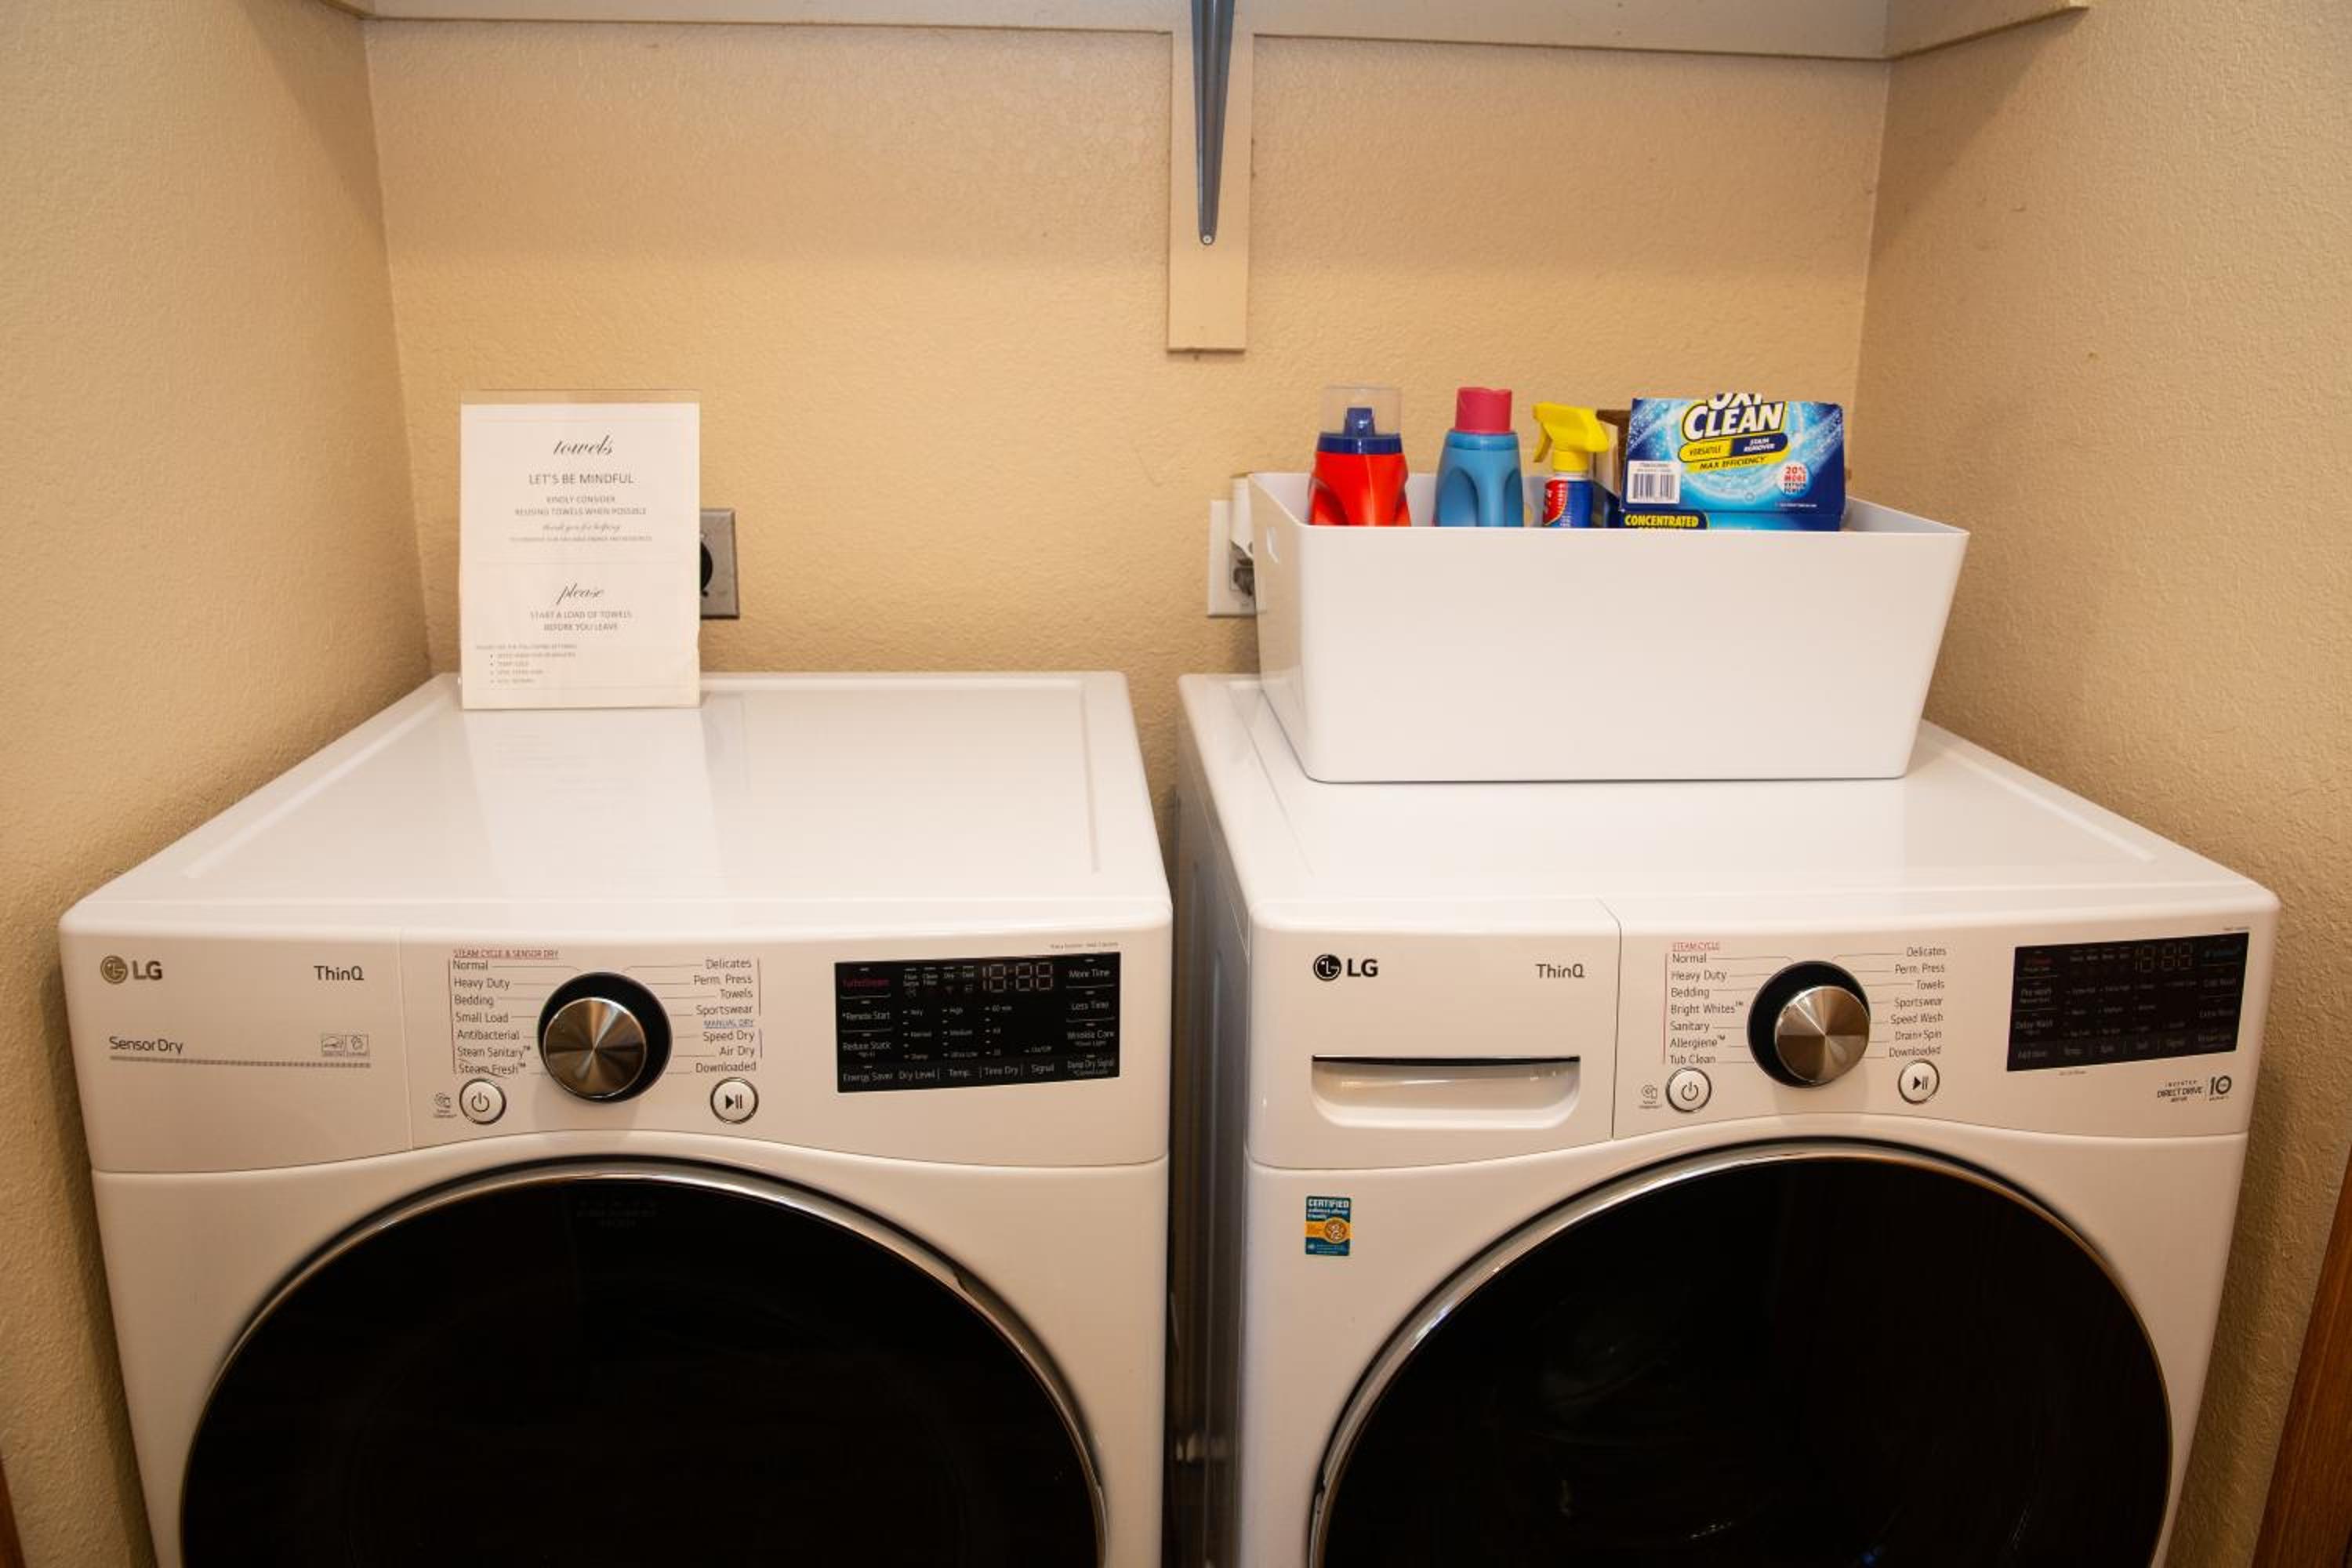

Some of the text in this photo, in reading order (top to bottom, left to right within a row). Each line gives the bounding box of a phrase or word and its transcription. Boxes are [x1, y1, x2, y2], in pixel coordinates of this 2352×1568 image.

[1683, 402, 1784, 441] CLEAN
[552, 434, 613, 455] towels
[1689, 445, 1721, 455] VERSATILE
[1721, 456, 1766, 467] EFFICIENCY
[528, 473, 634, 485] LET'S BE MINDFUL
[1624, 514, 1700, 528] CONCENTRATED
[555, 583, 604, 605] please
[1672, 942, 1719, 952] STEAM CYCLE
[1906, 946, 1947, 957] Delicates
[453, 949, 478, 958] STEAM
[481, 949, 502, 958] CYCLE
[511, 949, 542, 958] SENSOR
[543, 949, 560, 958] DRY
[1672, 953, 1707, 964] Normal
[132, 960, 164, 981] LG
[452, 960, 488, 971] Normal
[705, 959, 752, 970] Delicates
[1347, 958, 1379, 978] LG
[1922, 963, 1945, 973] Press
[314, 965, 365, 981] ThinQ
[1535, 963, 1585, 979] ThinQ
[1671, 970, 1727, 982] Heavy Duty
[454, 978, 510, 990] Heavy Duty
[725, 975, 753, 984] Press
[1916, 979, 1945, 990] Towels
[720, 988, 753, 998] Towels
[1671, 987, 1710, 999] Bedding
[454, 995, 494, 1008] Bedding
[1894, 996, 1944, 1009] Sportswear
[695, 1005, 753, 1017] Sportswear
[873, 1011, 890, 1019] Start
[1670, 1004, 1700, 1017] Bright
[456, 1012, 509, 1023] Small Load
[1890, 1012, 1944, 1025] Speed Wash
[704, 1019, 753, 1029] MANUAL DRY
[1670, 1021, 1710, 1033] Sanitary
[457, 1029, 520, 1040] Antibacterial
[702, 1029, 755, 1044] Speed Dry
[1097, 1030, 1115, 1039] Care
[457, 1047, 485, 1057] Steam
[719, 1045, 755, 1058] Air Dry
[842, 1041, 869, 1051] Reduce
[1889, 1045, 1941, 1058] Downloaded
[1670, 1054, 1716, 1065] Tub Clean
[459, 1065, 490, 1075] Steam
[695, 1061, 757, 1073] Downloaded
[985, 1065, 1018, 1076] Time Dry
[1031, 1063, 1054, 1075] Signal
[843, 1071, 894, 1083] Energy Saver
[899, 1069, 935, 1080] Dry Level
[2209, 1074, 2233, 1096] 10
[2157, 1086, 2203, 1098] DIRECT DRIVE
[1308, 1199, 1349, 1208] CERTIFIED
